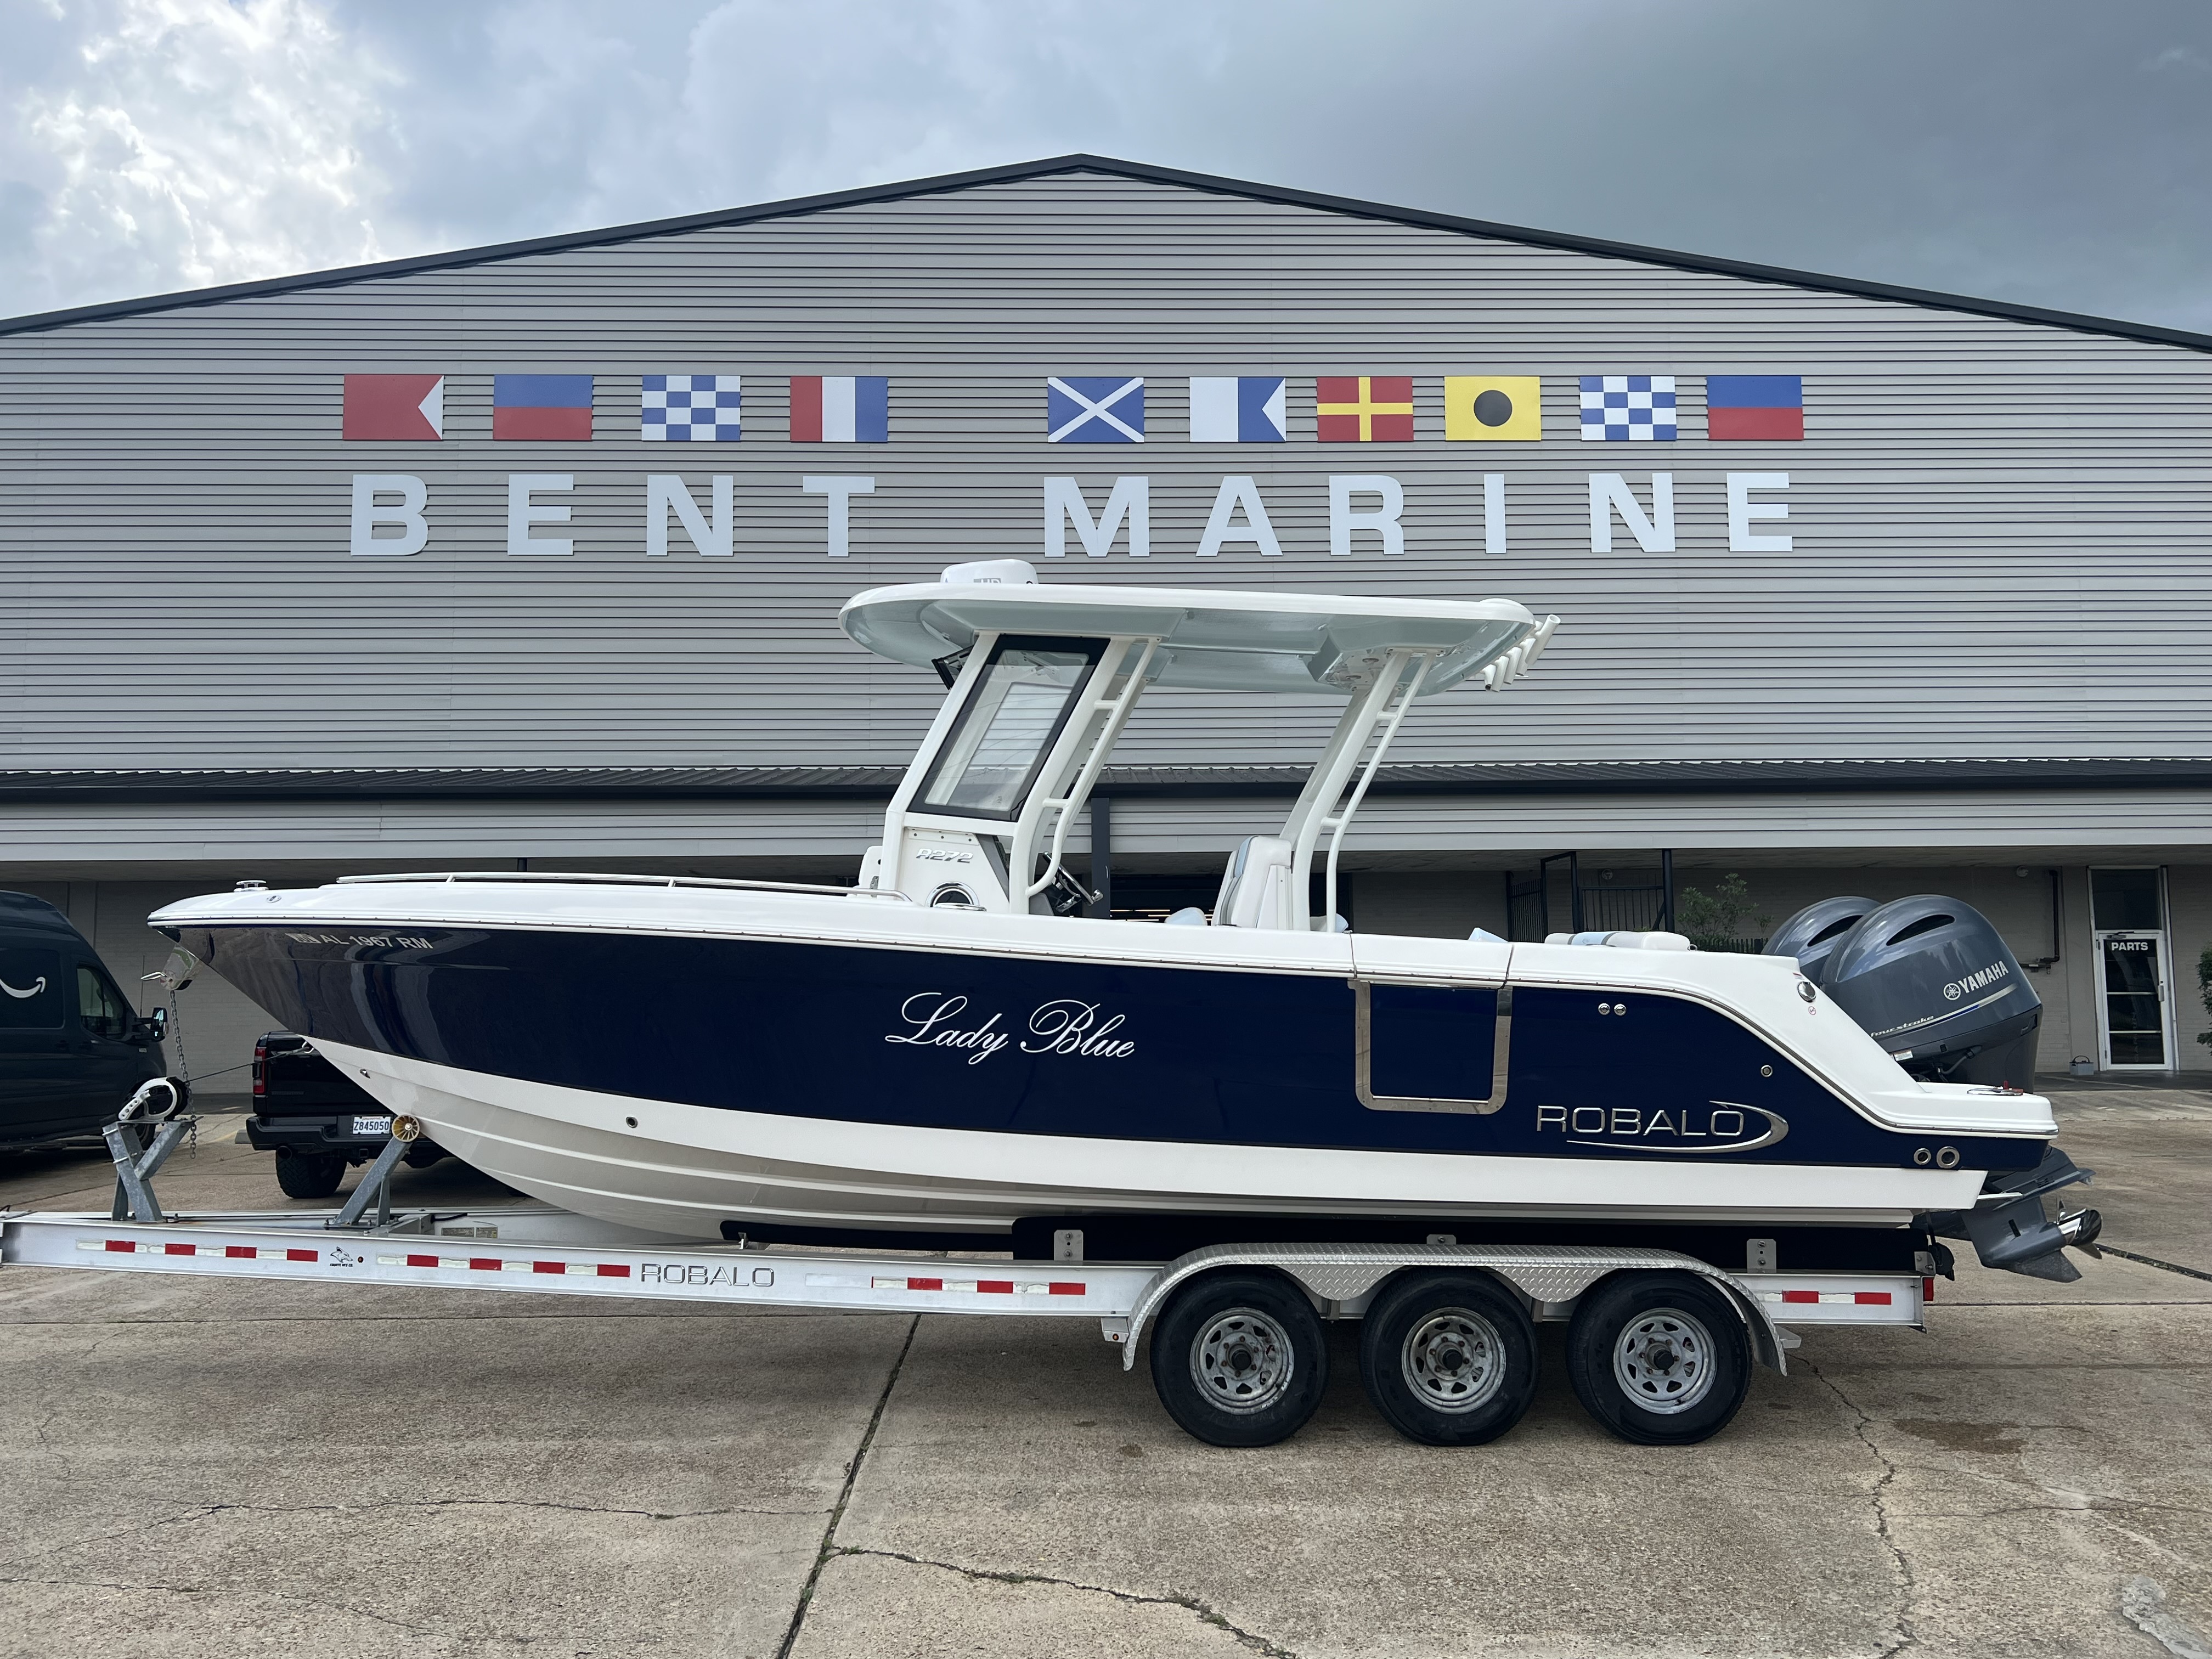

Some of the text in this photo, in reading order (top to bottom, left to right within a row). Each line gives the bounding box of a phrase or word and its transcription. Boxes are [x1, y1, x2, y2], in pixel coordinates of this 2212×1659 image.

[351, 472, 1793, 558] BENT MARINE
[916, 848, 973, 864] R272
[319, 934, 350, 945] AL
[349, 935, 393, 947] 1967
[396, 937, 433, 949] RM
[2111, 942, 2148, 951] PARTS
[1957, 960, 2009, 994] YAMAHA
[885, 992, 1135, 1065] Lady Blue
[353, 1121, 390, 1131] Z845050
[1536, 1105, 1745, 1137] ROBALO
[641, 1263, 775, 1286] ROBALO
